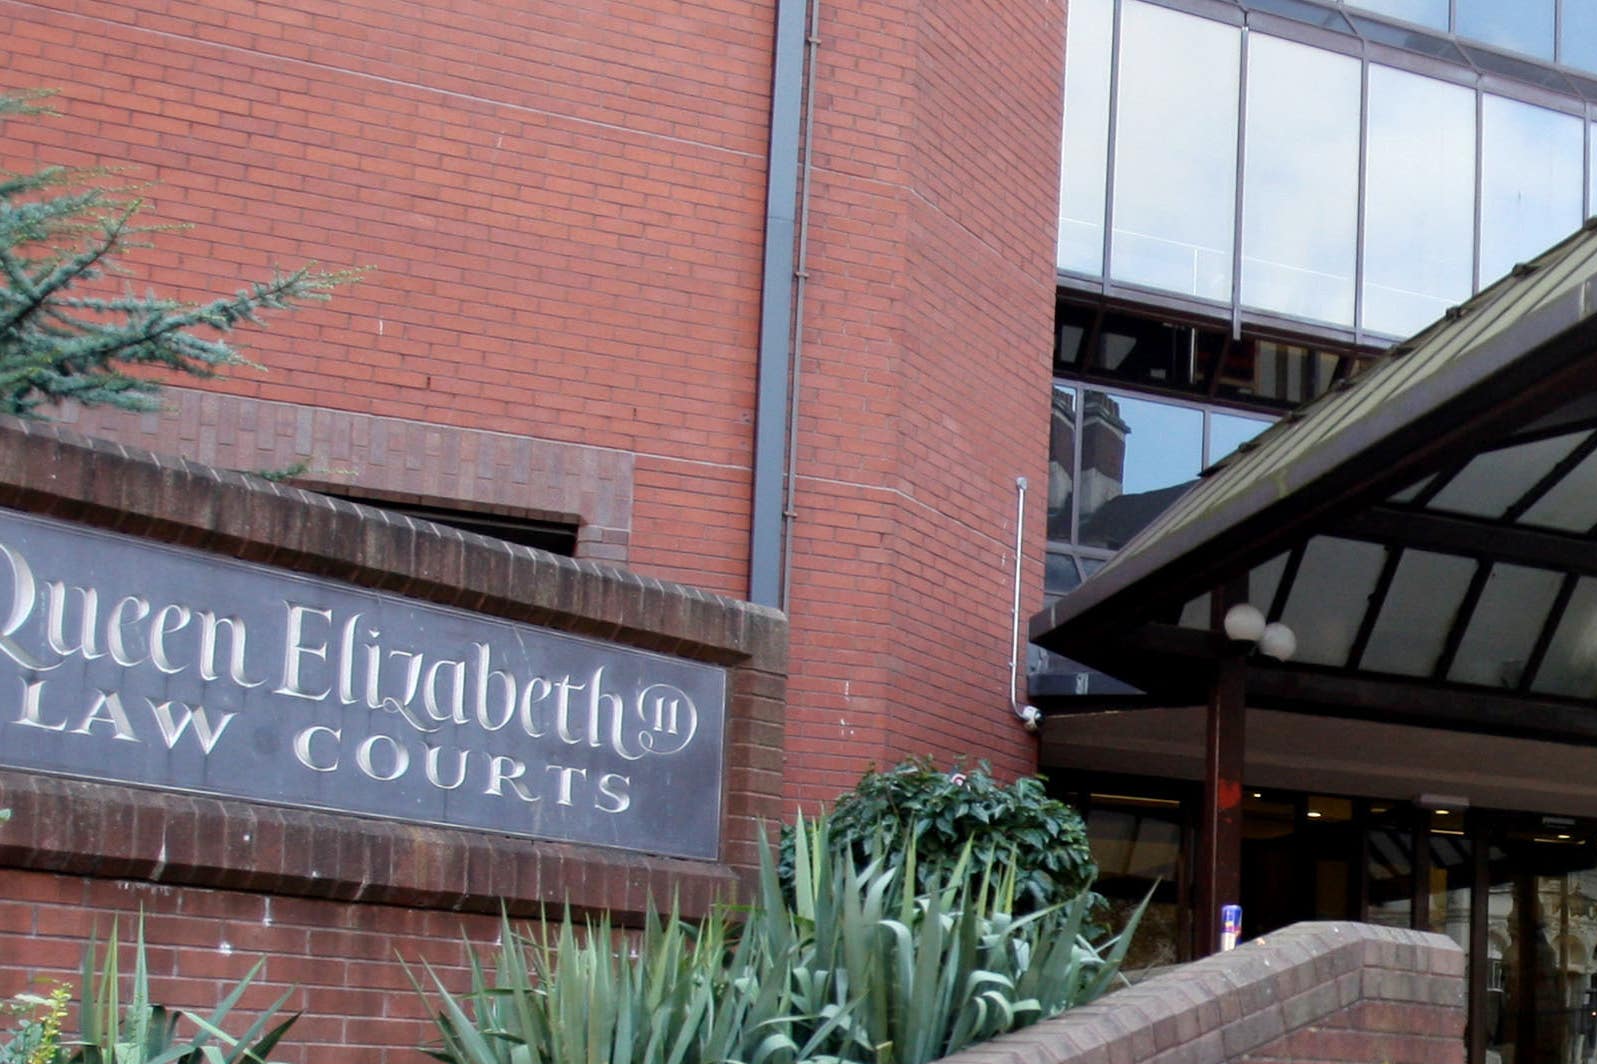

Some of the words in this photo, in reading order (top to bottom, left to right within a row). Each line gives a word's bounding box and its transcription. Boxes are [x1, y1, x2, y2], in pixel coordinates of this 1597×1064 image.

[9, 675, 239, 755] LAW
[293, 726, 631, 814] COURTS
[272, 600, 650, 760] Elizabeth
